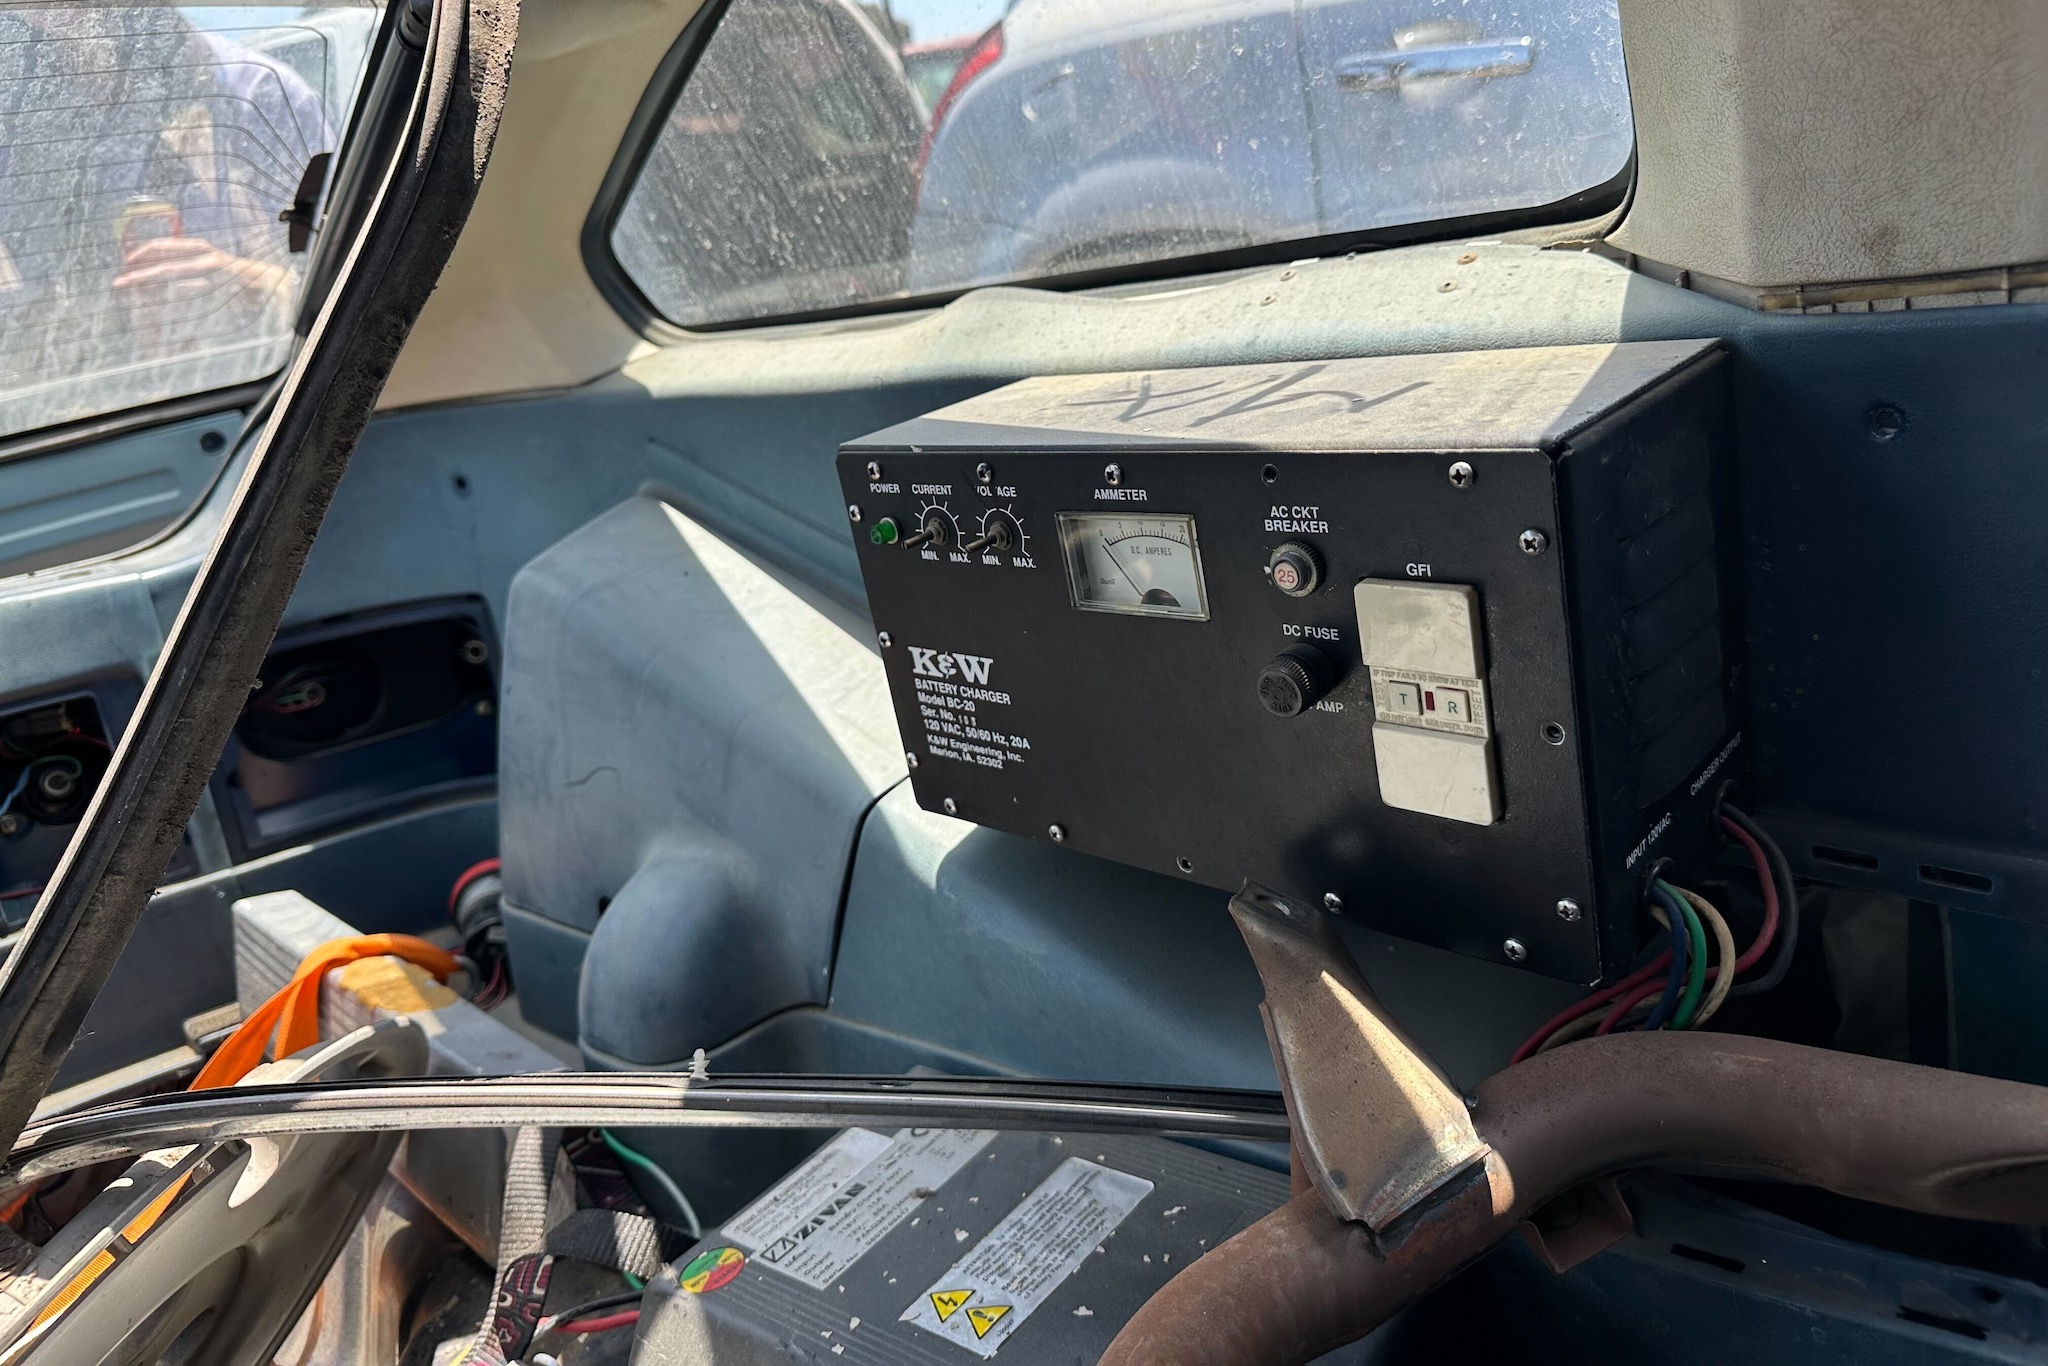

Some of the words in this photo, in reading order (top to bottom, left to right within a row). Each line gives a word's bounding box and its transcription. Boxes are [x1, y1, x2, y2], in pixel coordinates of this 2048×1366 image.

[870, 483, 900, 494] POWER
[912, 484, 952, 496] CURRENT
[1094, 488, 1148, 500] AMMETER
[1270, 506, 1288, 518] AC
[1292, 506, 1319, 519] CKT
[1264, 520, 1329, 534] BREAKER
[920, 550, 940, 561] MIN.
[949, 552, 972, 564] MAX.
[1131, 546, 1142, 554] D.C.
[1146, 546, 1172, 556] AMPERES
[982, 554, 1002, 566] MIN.
[1012, 557, 1037, 569] MAX.
[1277, 568, 1295, 584] 25
[1406, 562, 1432, 577] GFI
[1282, 624, 1301, 637] DC
[1304, 626, 1340, 641] FUSE
[908, 646, 994, 686] K&W
[914, 678, 958, 696] BATTERY
[960, 686, 1011, 705] CHARGER
[1399, 693, 1408, 705] T
[918, 692, 945, 706] Model
[947, 698, 976, 712] BC-20
[1316, 700, 1344, 713] AMP
[1448, 701, 1458, 714] R
[1471, 689, 1484, 726] RESET
[920, 704, 939, 718] Ser.
[940, 708, 956, 722] No.
[924, 719, 940, 731] 120
[940, 722, 965, 738] VAC,
[966, 726, 990, 741] 50/60
[992, 732, 1009, 746] Hz,
[1010, 735, 1031, 750] 20A
[927, 734, 948, 746] K&W
[1007, 751, 1024, 762] Inc.
[930, 745, 962, 760] Marion,
[977, 756, 1004, 769] 52302
[1690, 758, 1720, 796] CHARGER
[1719, 731, 1742, 763] OUTPUT
[1626, 838, 1647, 870] INPUT
[1648, 812, 1672, 845] 120VAC
[791, 1182, 868, 1240] ZIVAN
